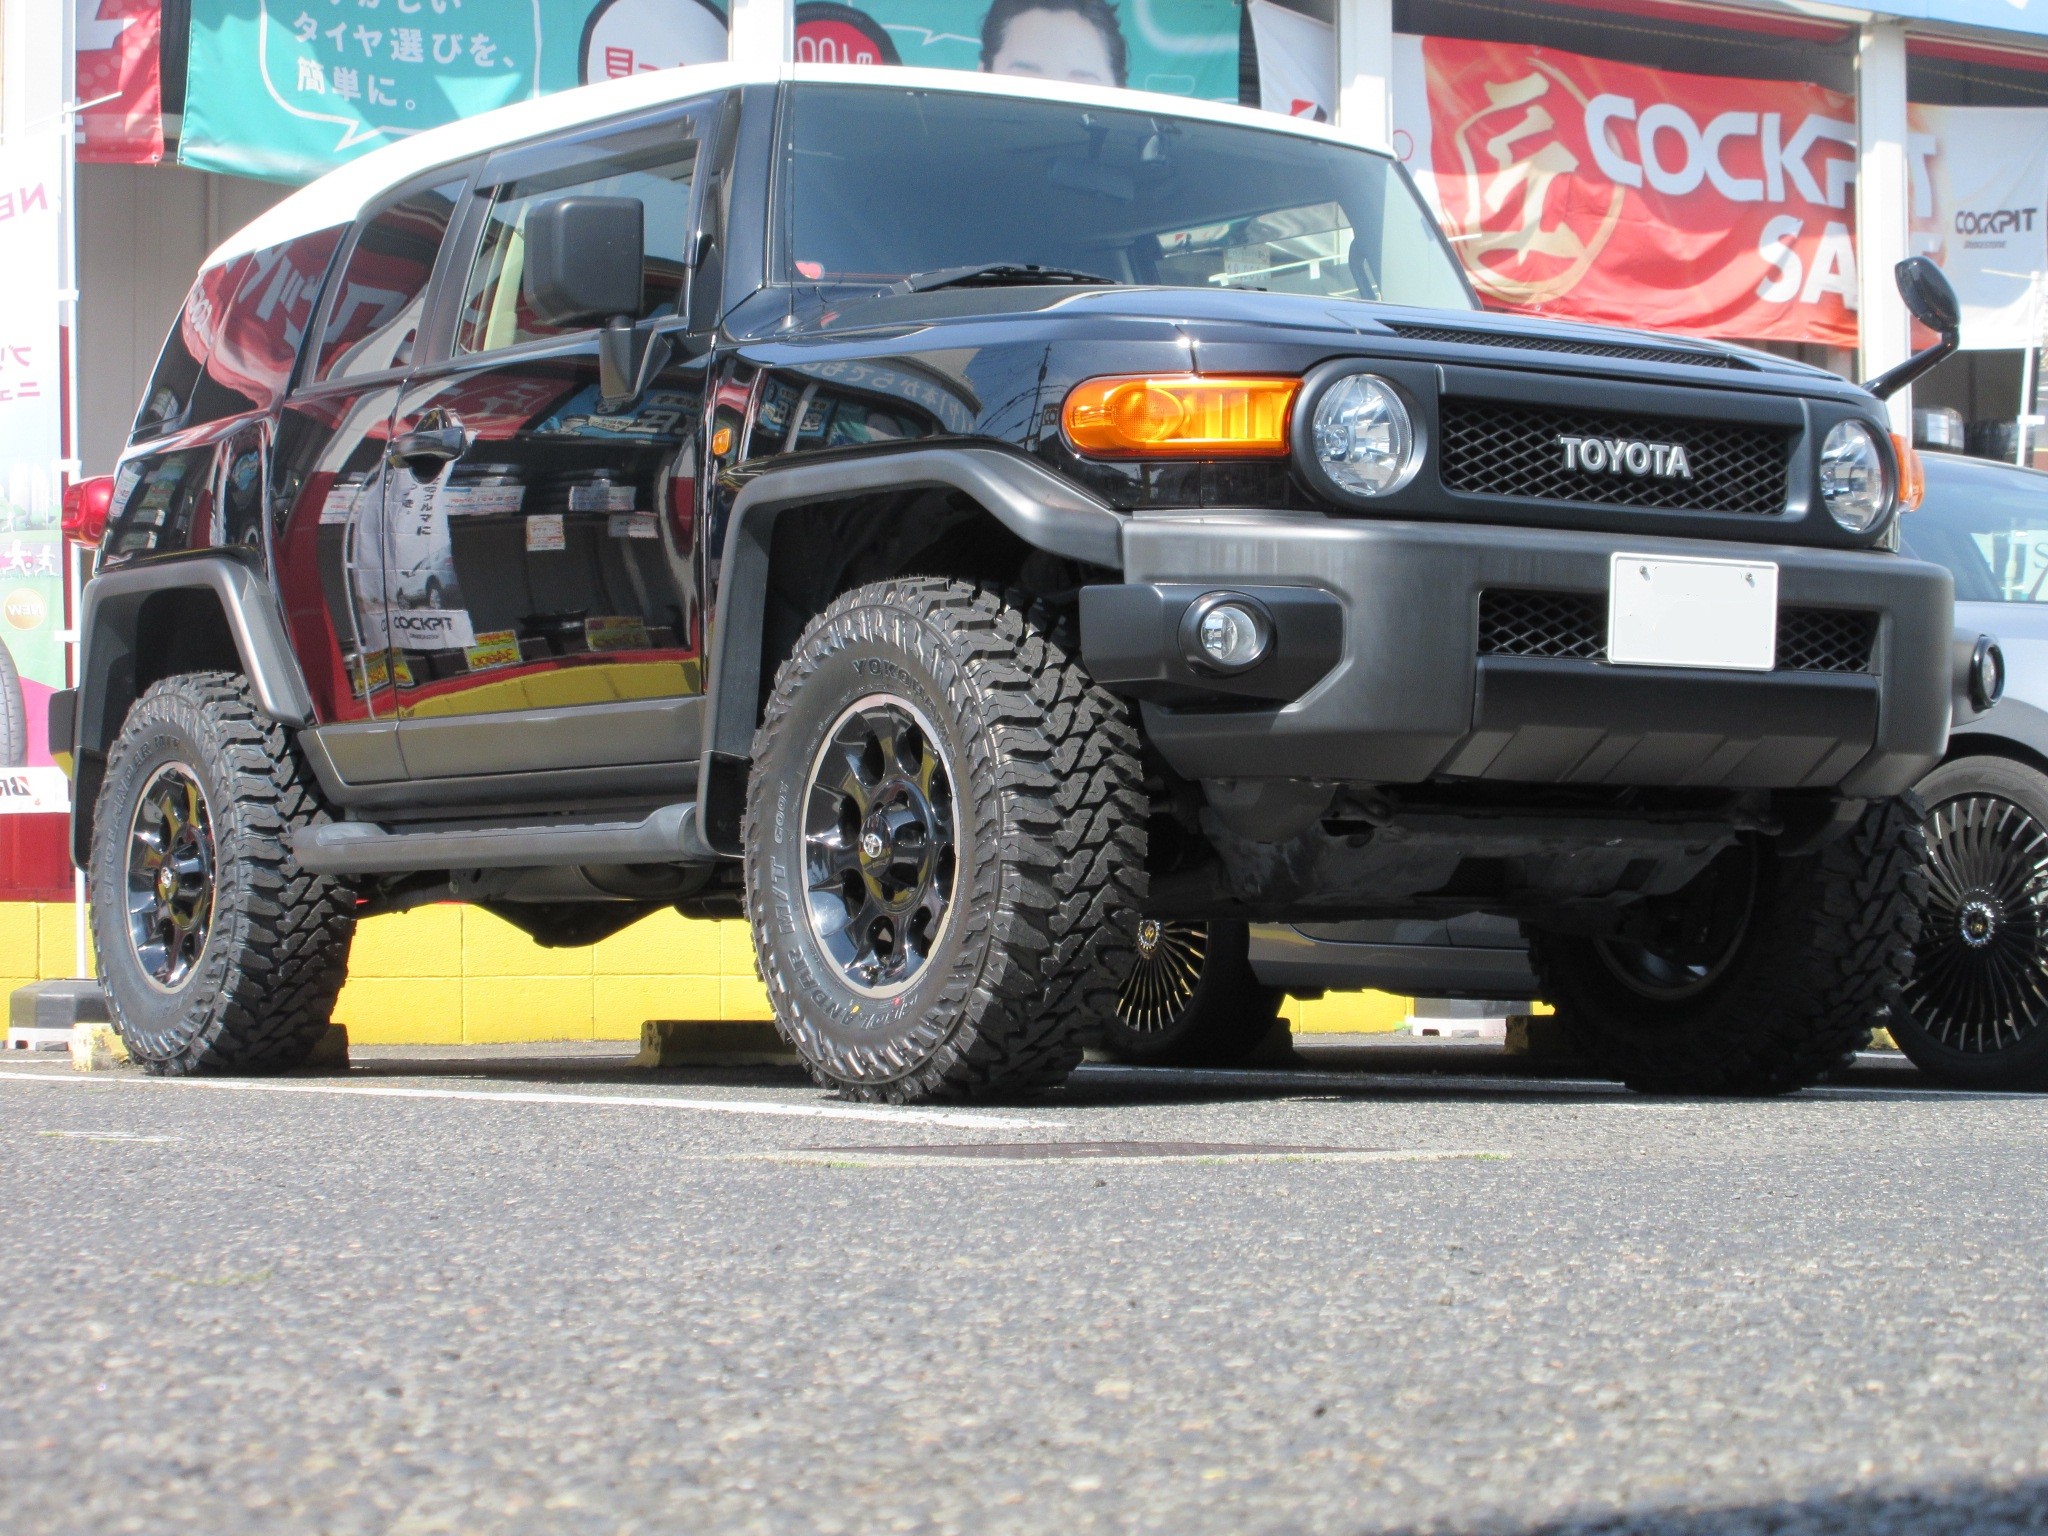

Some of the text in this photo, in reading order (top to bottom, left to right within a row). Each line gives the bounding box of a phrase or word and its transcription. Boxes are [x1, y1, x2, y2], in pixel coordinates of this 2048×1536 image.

[293, 11, 514, 68] タイヤ選びを、
[297, 56, 416, 110] 簡単に。
[1585, 93, 1936, 218] COCKPT
[1955, 208, 2038, 234] COCKPIT
[1559, 435, 1692, 480] TOYOTA
[394, 616, 452, 631] COCKPIT
